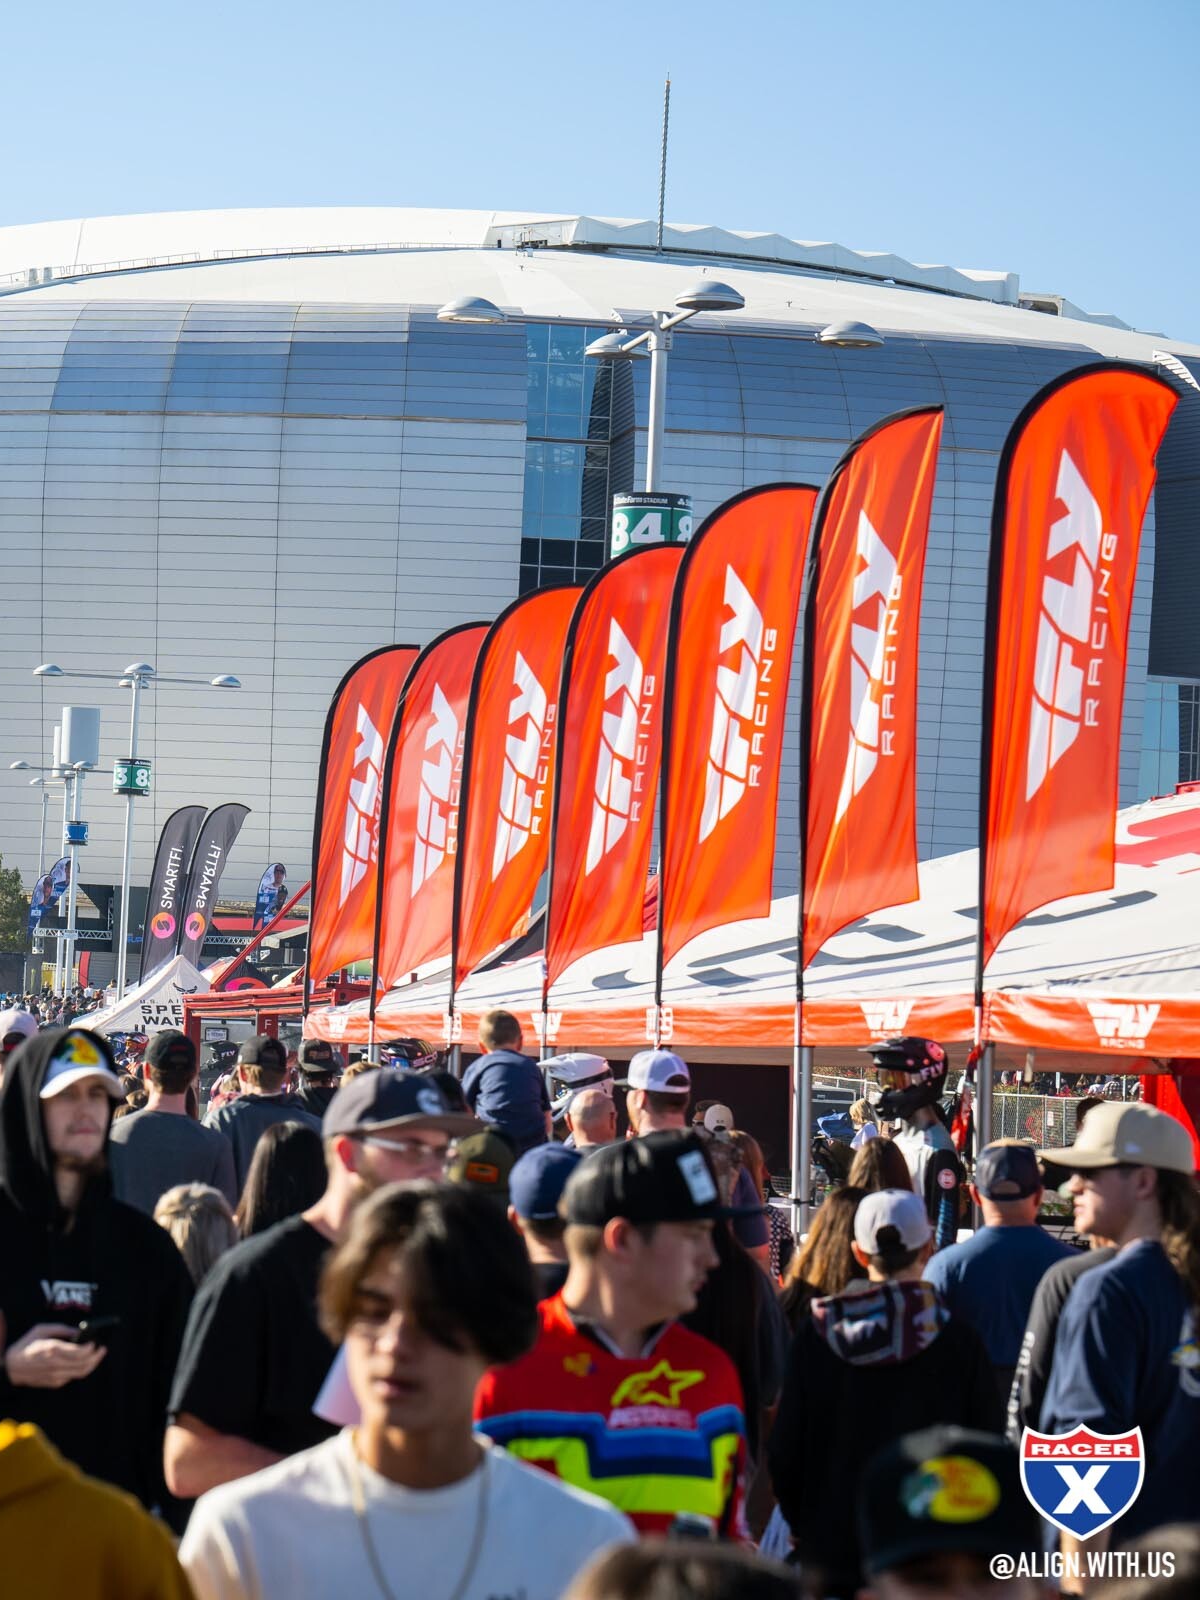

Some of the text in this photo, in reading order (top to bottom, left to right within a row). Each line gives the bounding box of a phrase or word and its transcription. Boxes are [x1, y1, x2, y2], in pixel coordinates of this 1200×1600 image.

[612, 512, 665, 551] 84
[835, 508, 898, 826] FLY
[881, 573, 904, 757] RACING
[1026, 448, 1102, 802] FLY
[1085, 533, 1118, 727] RACING
[492, 650, 547, 883] FLY
[531, 703, 556, 835] RACING
[585, 617, 643, 877] FLY
[630, 674, 655, 823] RACING
[699, 563, 764, 845] FLY
[749, 628, 777, 787] RACING
[338, 703, 383, 910] FLY
[411, 682, 458, 898] FLY
[141, 1005, 182, 1015] SPE
[143, 1016, 184, 1026] WAR
[860, 1000, 915, 1031] FLY
[919, 1061, 944, 1081] FLY
[1086, 1003, 1161, 1038] FLY
[1101, 1038, 1144, 1049] RACING
[41, 1280, 92, 1305] VANS
